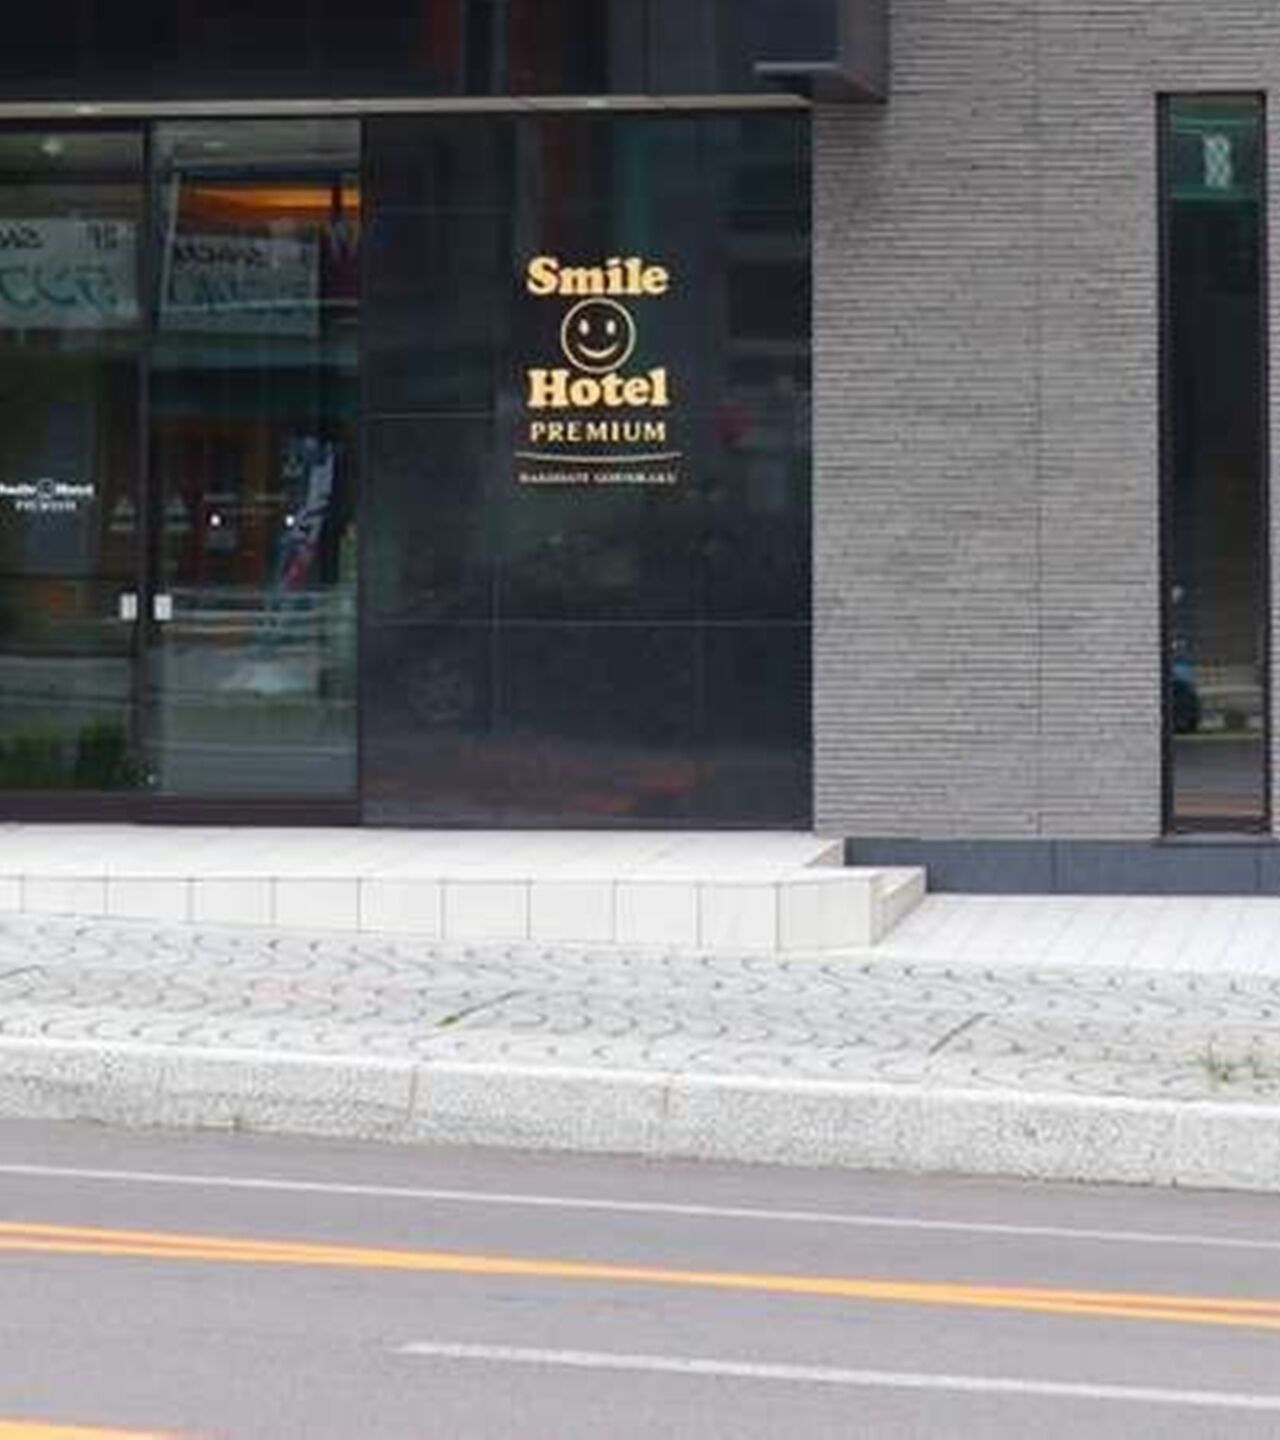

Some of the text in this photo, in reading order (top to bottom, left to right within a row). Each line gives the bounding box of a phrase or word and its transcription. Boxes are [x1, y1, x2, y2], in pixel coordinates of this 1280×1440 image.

[526, 256, 670, 296] Smile
[526, 367, 670, 409] Hotel
[530, 421, 667, 443] PREMIUM
